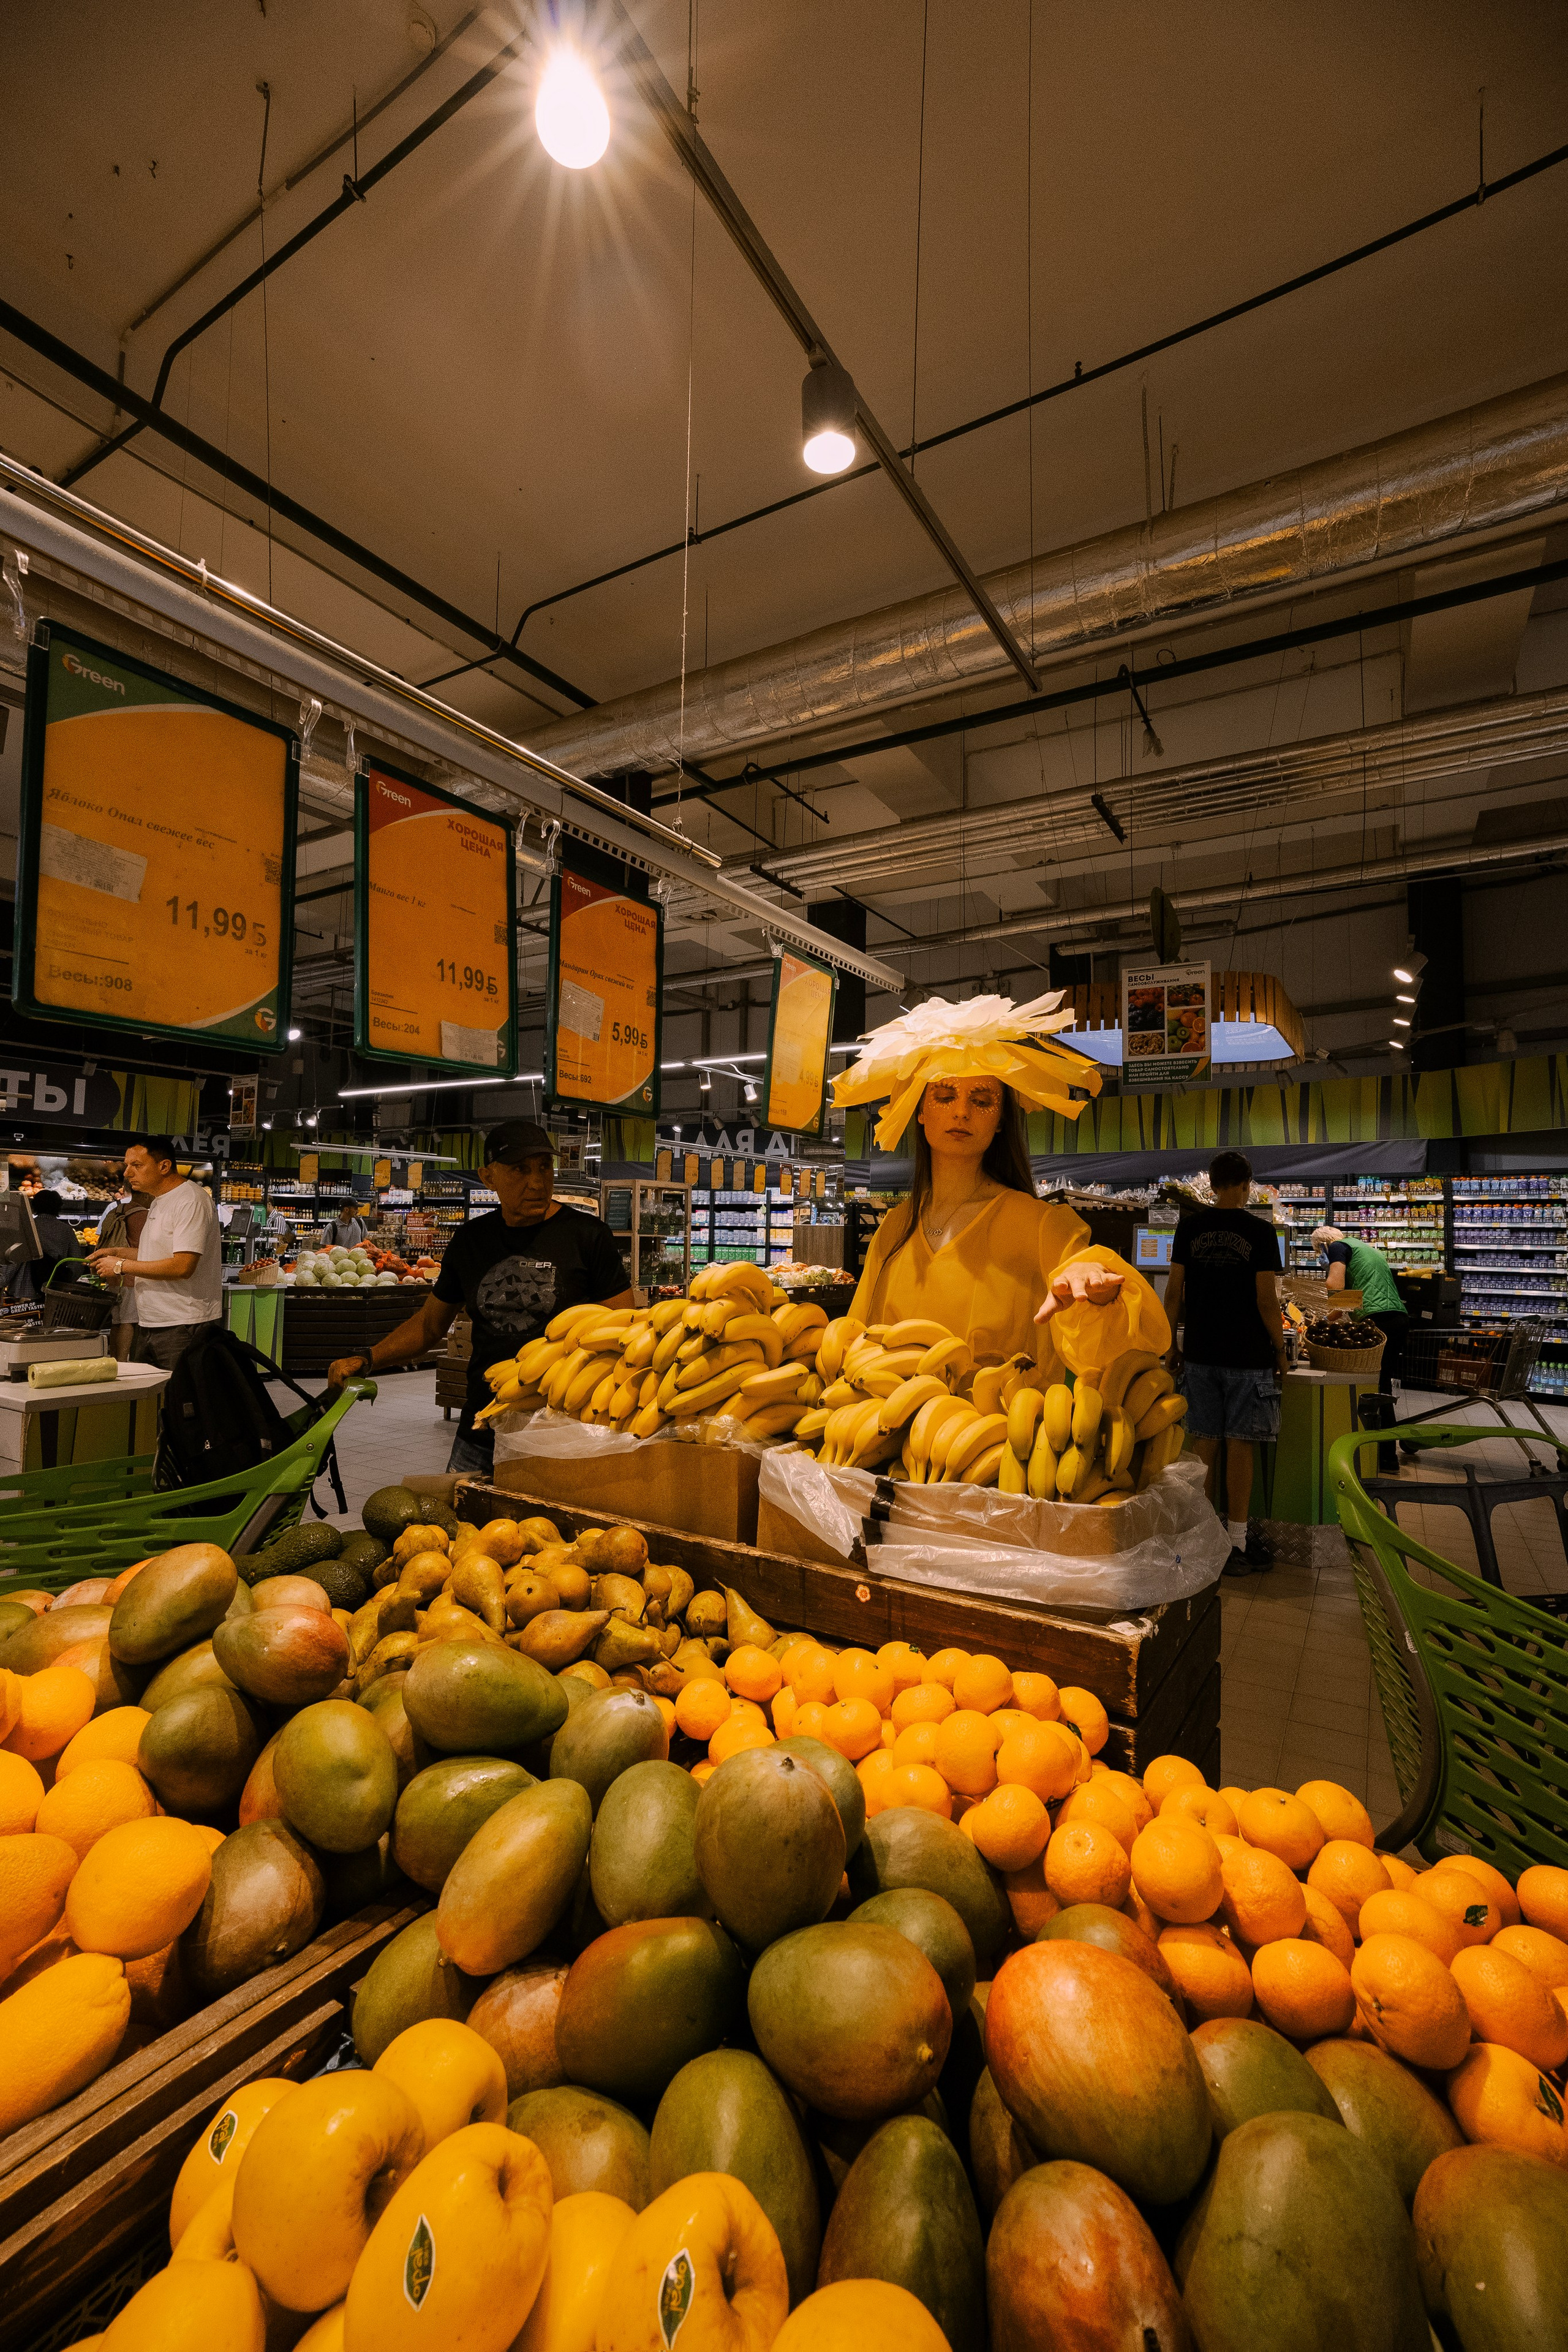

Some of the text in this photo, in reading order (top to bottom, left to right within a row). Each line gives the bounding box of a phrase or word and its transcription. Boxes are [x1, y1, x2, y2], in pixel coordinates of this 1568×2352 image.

[62, 654, 125, 696] Green
[376, 781, 411, 807] Green
[46, 788, 104, 813] Яблоко
[108, 806, 143, 827] Опал
[146, 821, 193, 842] свежее
[196, 835, 216, 849] вес
[447, 818, 503, 852] ХОРОШАЯ
[461, 837, 491, 858] ЦЕНА
[369, 881, 395, 897] Манго
[397, 894, 410, 902] вес
[567, 876, 591, 897] Green
[615, 904, 655, 929] ХОРОШАЯ
[625, 919, 646, 936] ЦЕНА
[560, 959, 589, 974] Мандарин
[784, 958, 796, 973] Green
[49, 964, 133, 991] Весы:908
[804, 977, 831, 996] ХОРОШАЯ
[1128, 974, 1154, 982] ВЕСЫ
[1128, 978, 1180, 987] САМООБСЛУЖИВАНИЯ
[372, 1017, 421, 1036] Весы:204
[559, 1070, 592, 1084] Весы:692
[215, 2115, 232, 2143] opal
[410, 2247, 430, 2299] opal
